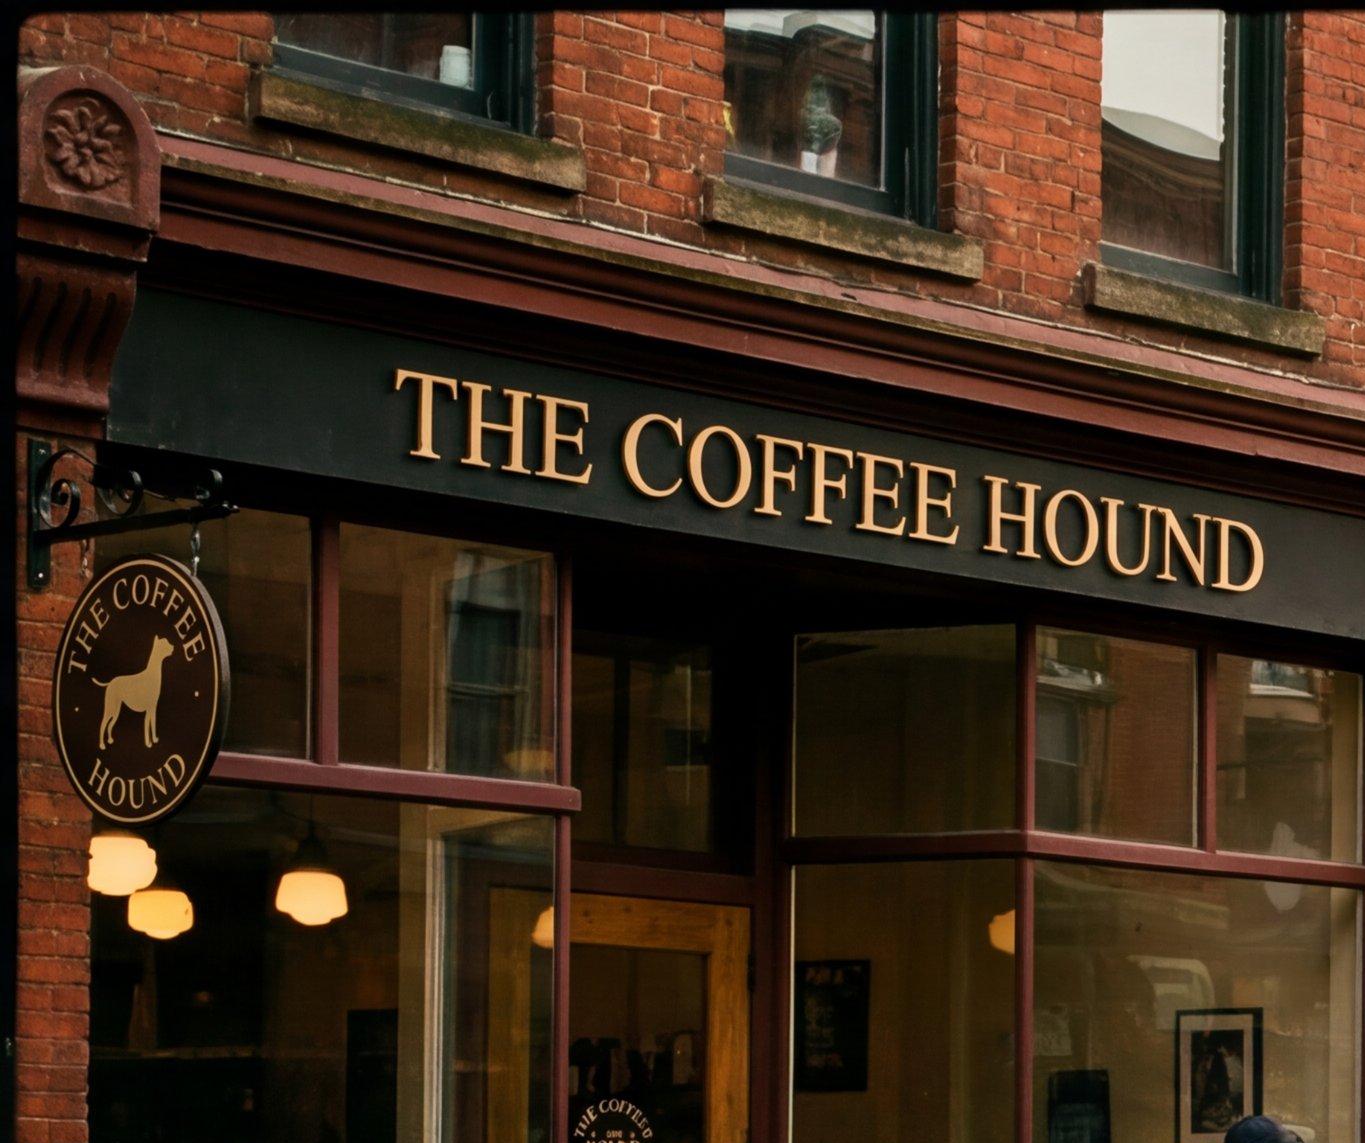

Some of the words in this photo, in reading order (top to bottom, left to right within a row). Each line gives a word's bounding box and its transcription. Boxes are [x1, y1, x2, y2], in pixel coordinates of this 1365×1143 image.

[394, 368, 593, 485] THE
[621, 413, 960, 545] COFFEE
[982, 474, 1265, 593] HOUND
[67, 598, 110, 674] THE
[112, 574, 206, 662] COFFEE
[88, 753, 186, 810] HOUND
